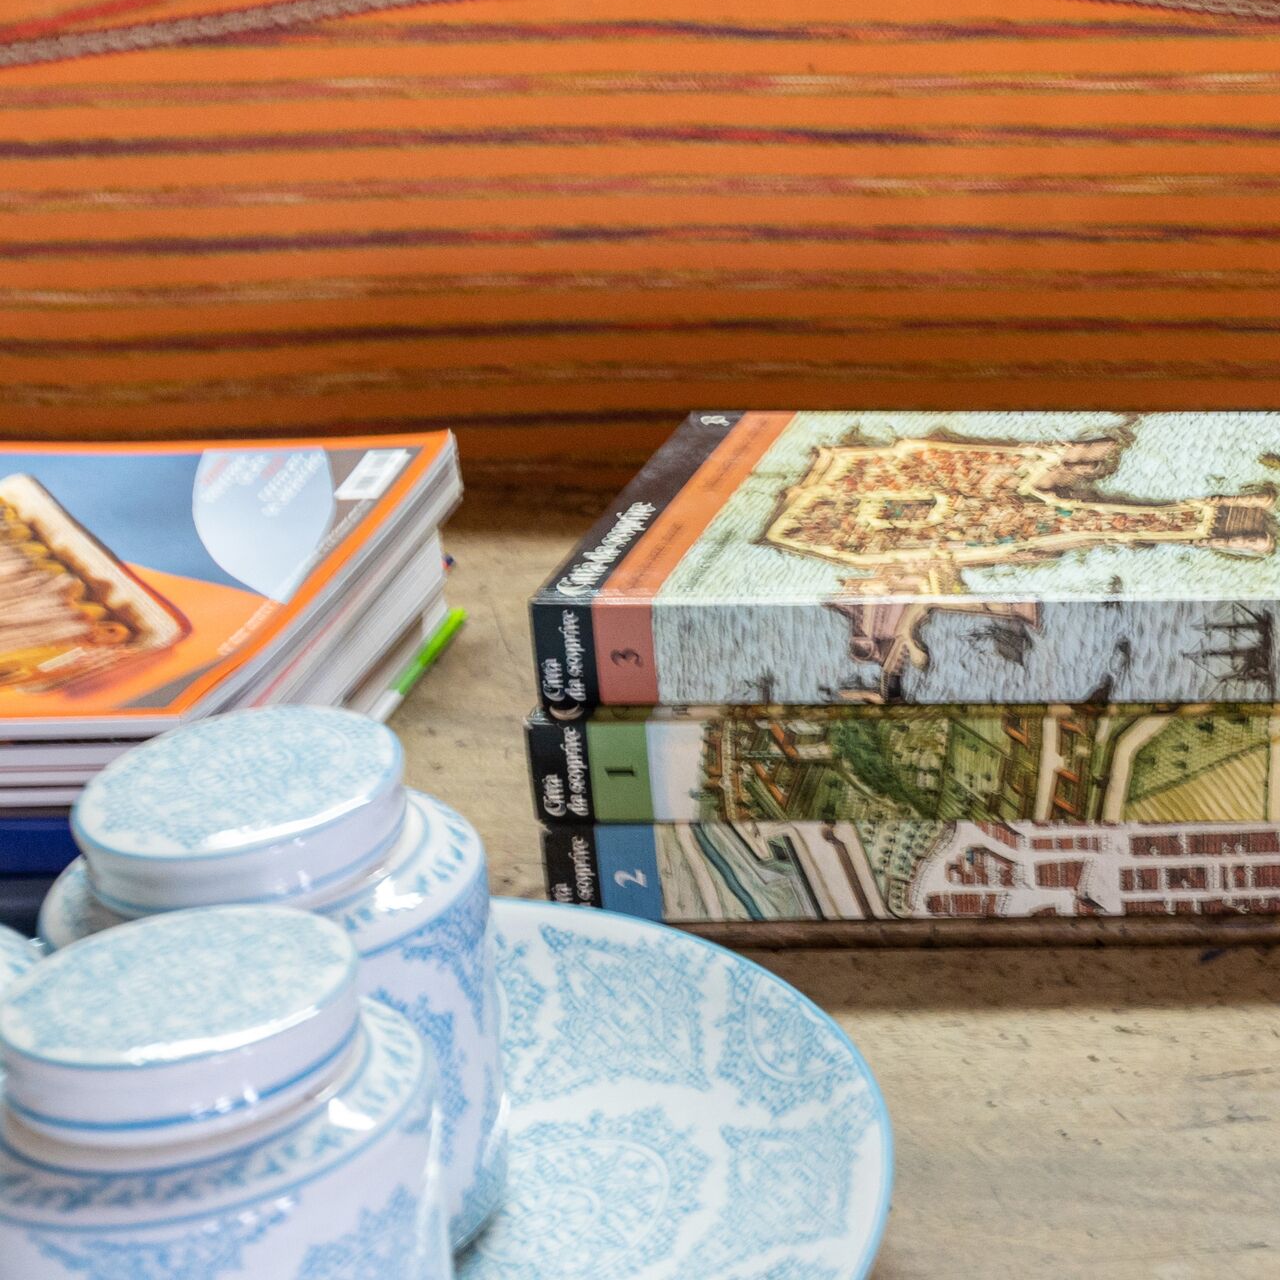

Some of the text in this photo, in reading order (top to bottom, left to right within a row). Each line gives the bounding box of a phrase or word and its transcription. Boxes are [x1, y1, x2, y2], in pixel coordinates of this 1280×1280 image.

[601, 502, 657, 548] scoprire
[558, 609, 588, 702] da scoprire
[611, 647, 644, 668] 3
[542, 658, 566, 702] Città
[559, 727, 590, 817] da scoprire
[605, 765, 636, 778] 1
[542, 774, 567, 817] Città
[567, 835, 596, 901] scoprire
[614, 869, 649, 889] 2
